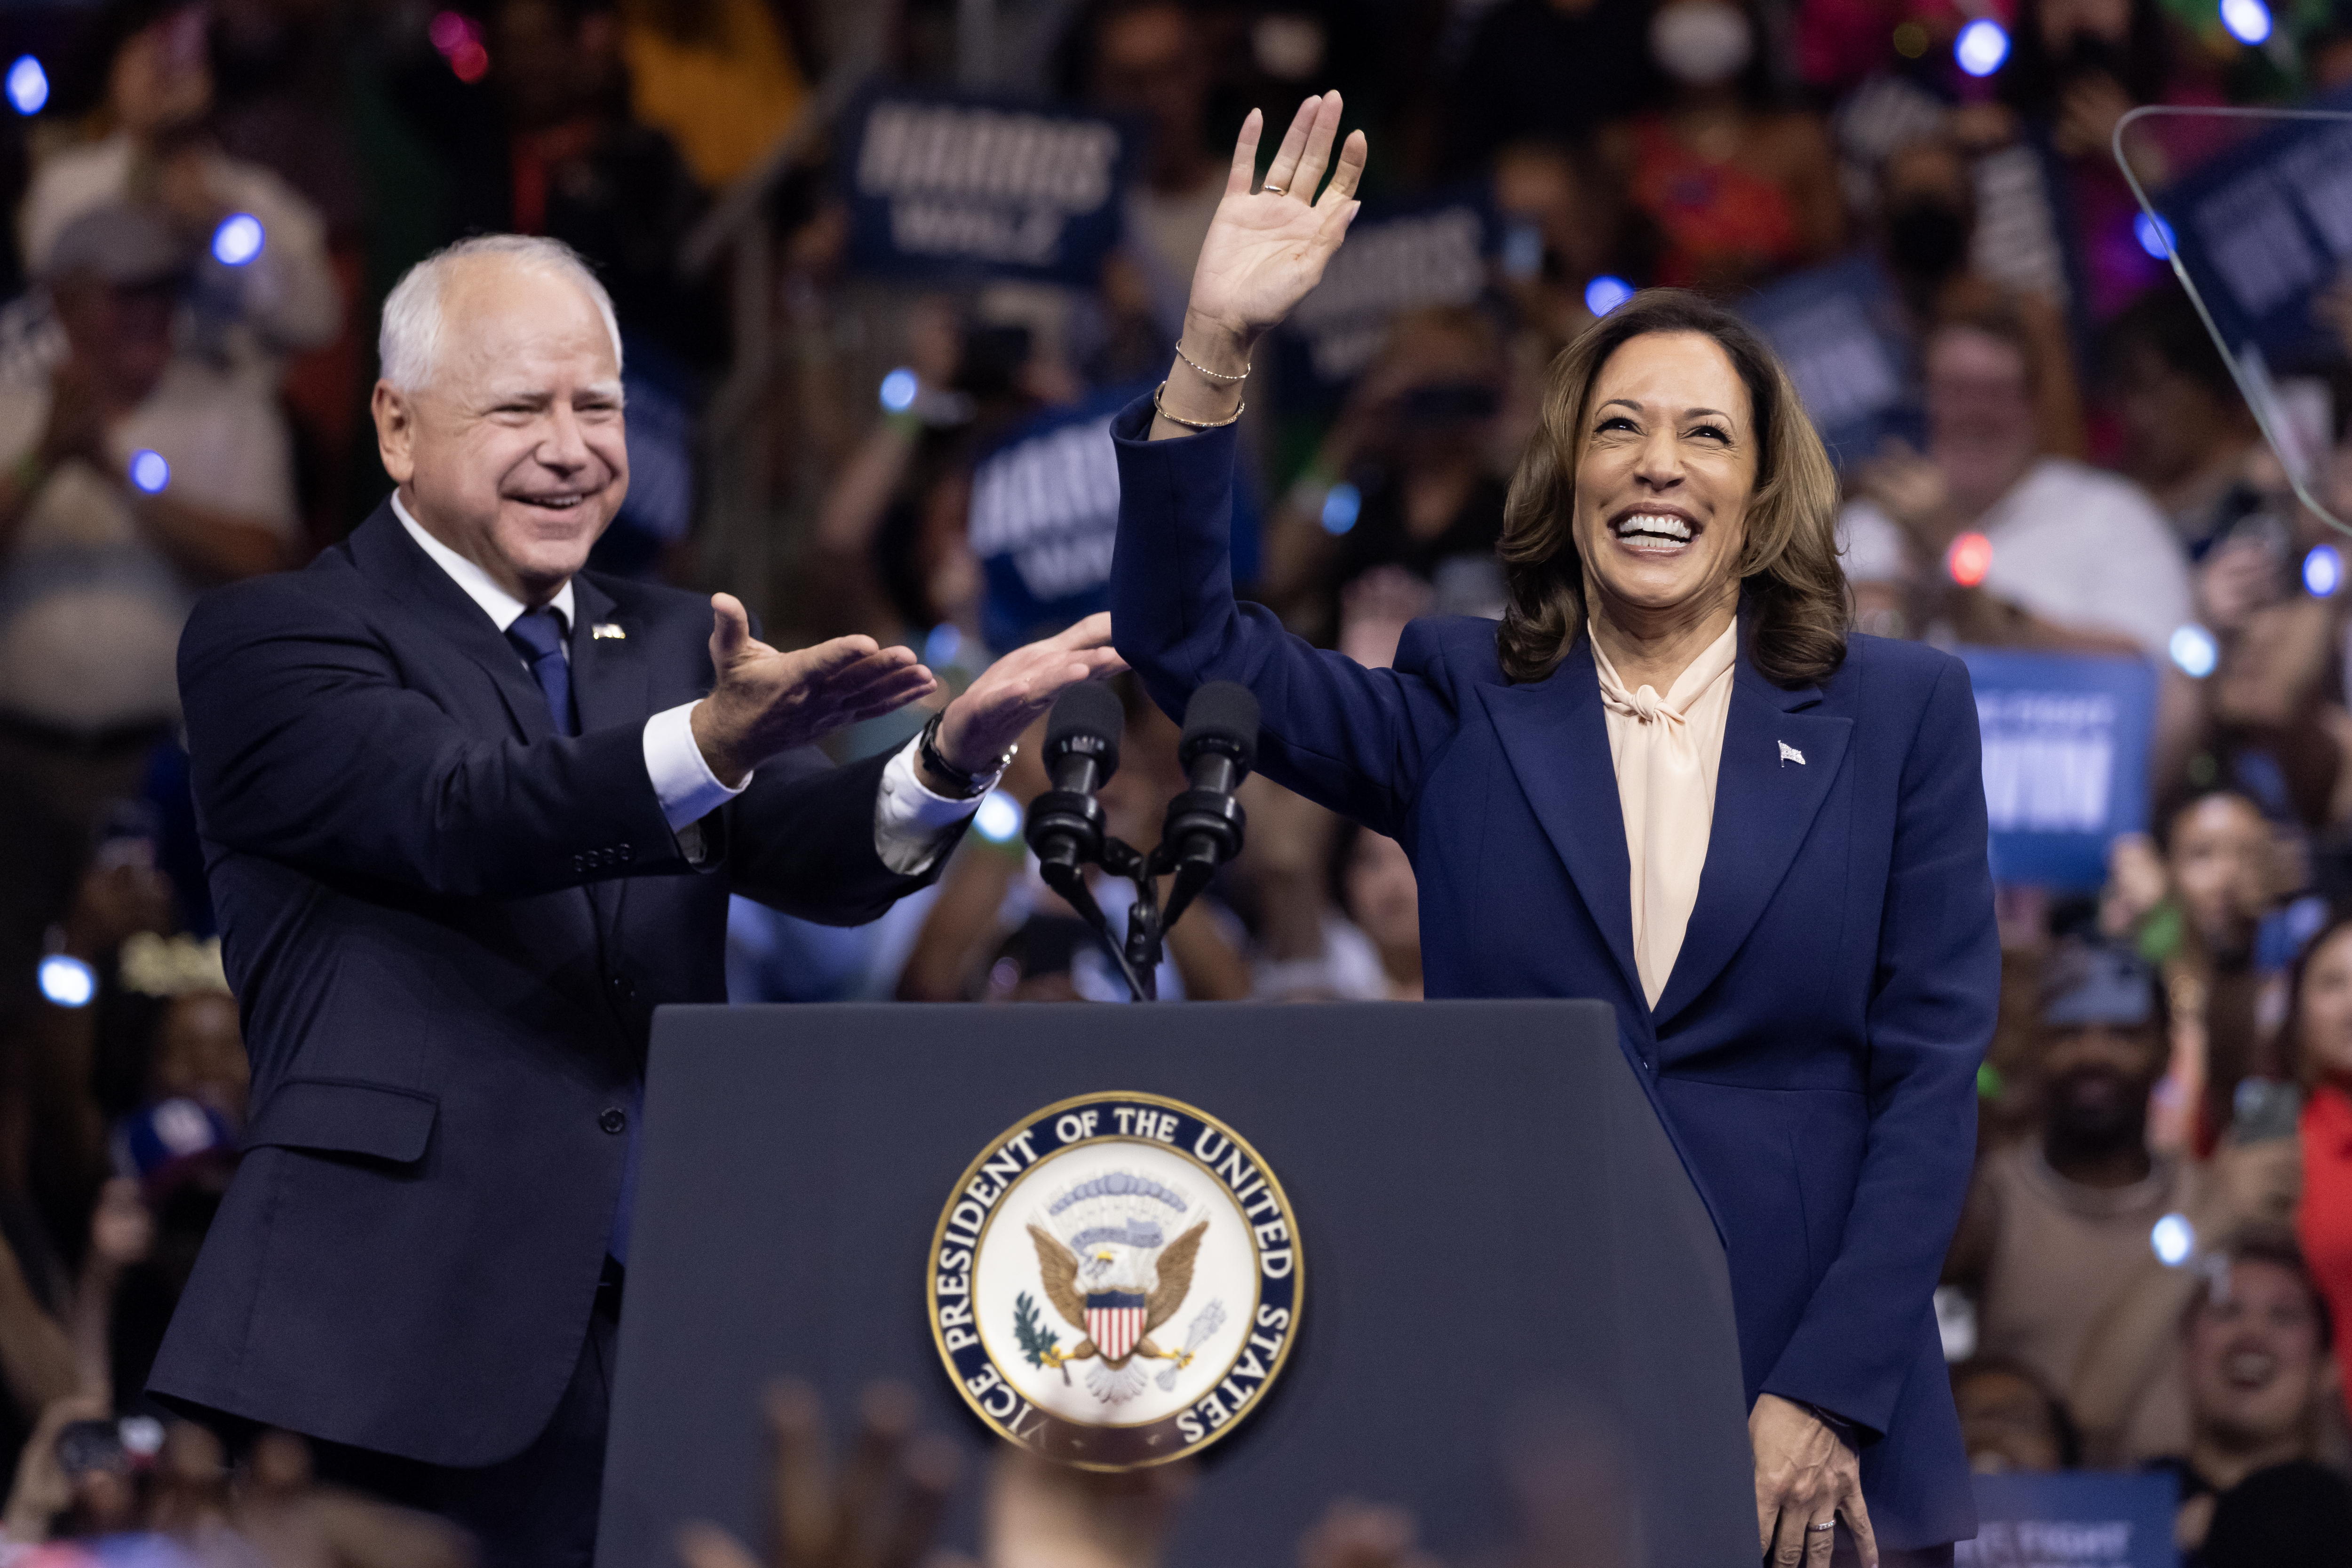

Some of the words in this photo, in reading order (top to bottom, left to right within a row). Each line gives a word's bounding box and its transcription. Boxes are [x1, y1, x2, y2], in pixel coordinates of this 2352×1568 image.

[1056, 1110, 1098, 1143] OF
[1113, 1107, 1179, 1143] THE
[937, 1130, 1039, 1352] PRESIDENT
[1193, 1126, 1293, 1279] UNITED
[967, 1363, 1048, 1449] VICE
[1176, 1304, 1289, 1443] STATES
